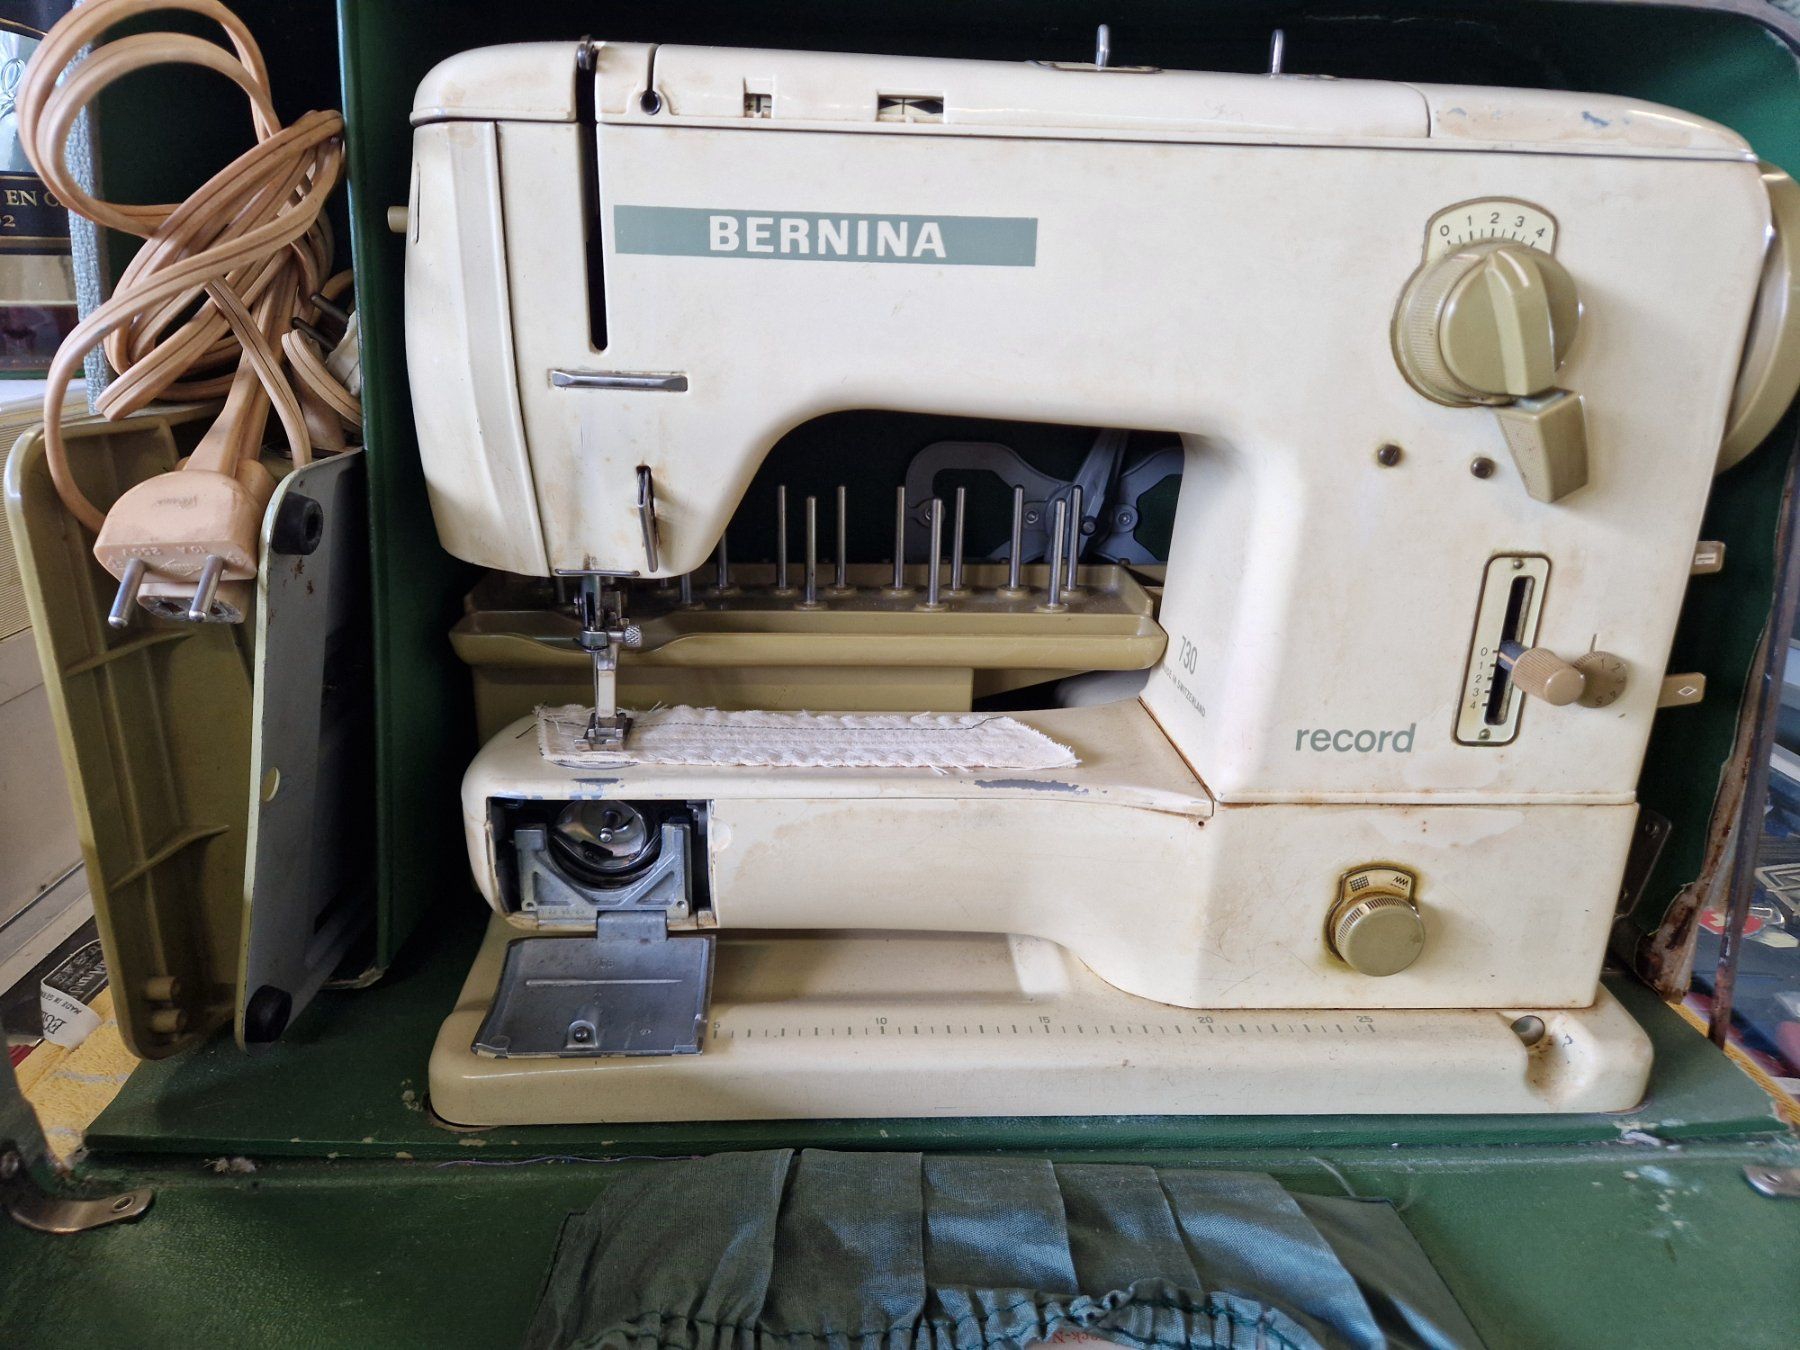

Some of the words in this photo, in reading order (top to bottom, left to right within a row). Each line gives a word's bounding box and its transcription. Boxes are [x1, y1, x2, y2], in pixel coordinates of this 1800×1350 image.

[4, 189, 38, 207] EN
[1439, 224, 1450, 237] 0
[1466, 214, 1473, 226] 1
[1490, 212, 1500, 224] 2
[1515, 215, 1526, 228] 3
[1535, 227, 1546, 238] 4
[709, 215, 947, 258] BERNINA
[1179, 635, 1198, 675] 730
[1480, 647, 1488, 657] 0
[1478, 661, 1484, 670] 1
[1474, 674, 1482, 683] 2
[1176, 679, 1206, 718] SWITZERLAND
[1472, 688, 1480, 697] 3
[1470, 701, 1477, 709] 4
[1295, 722, 1418, 754] record
[713, 1021, 721, 1029] 5
[875, 1017, 887, 1025] 10
[1038, 1016, 1051, 1024] 15
[1198, 1016, 1213, 1024] 20
[1357, 1015, 1373, 1024] 25
